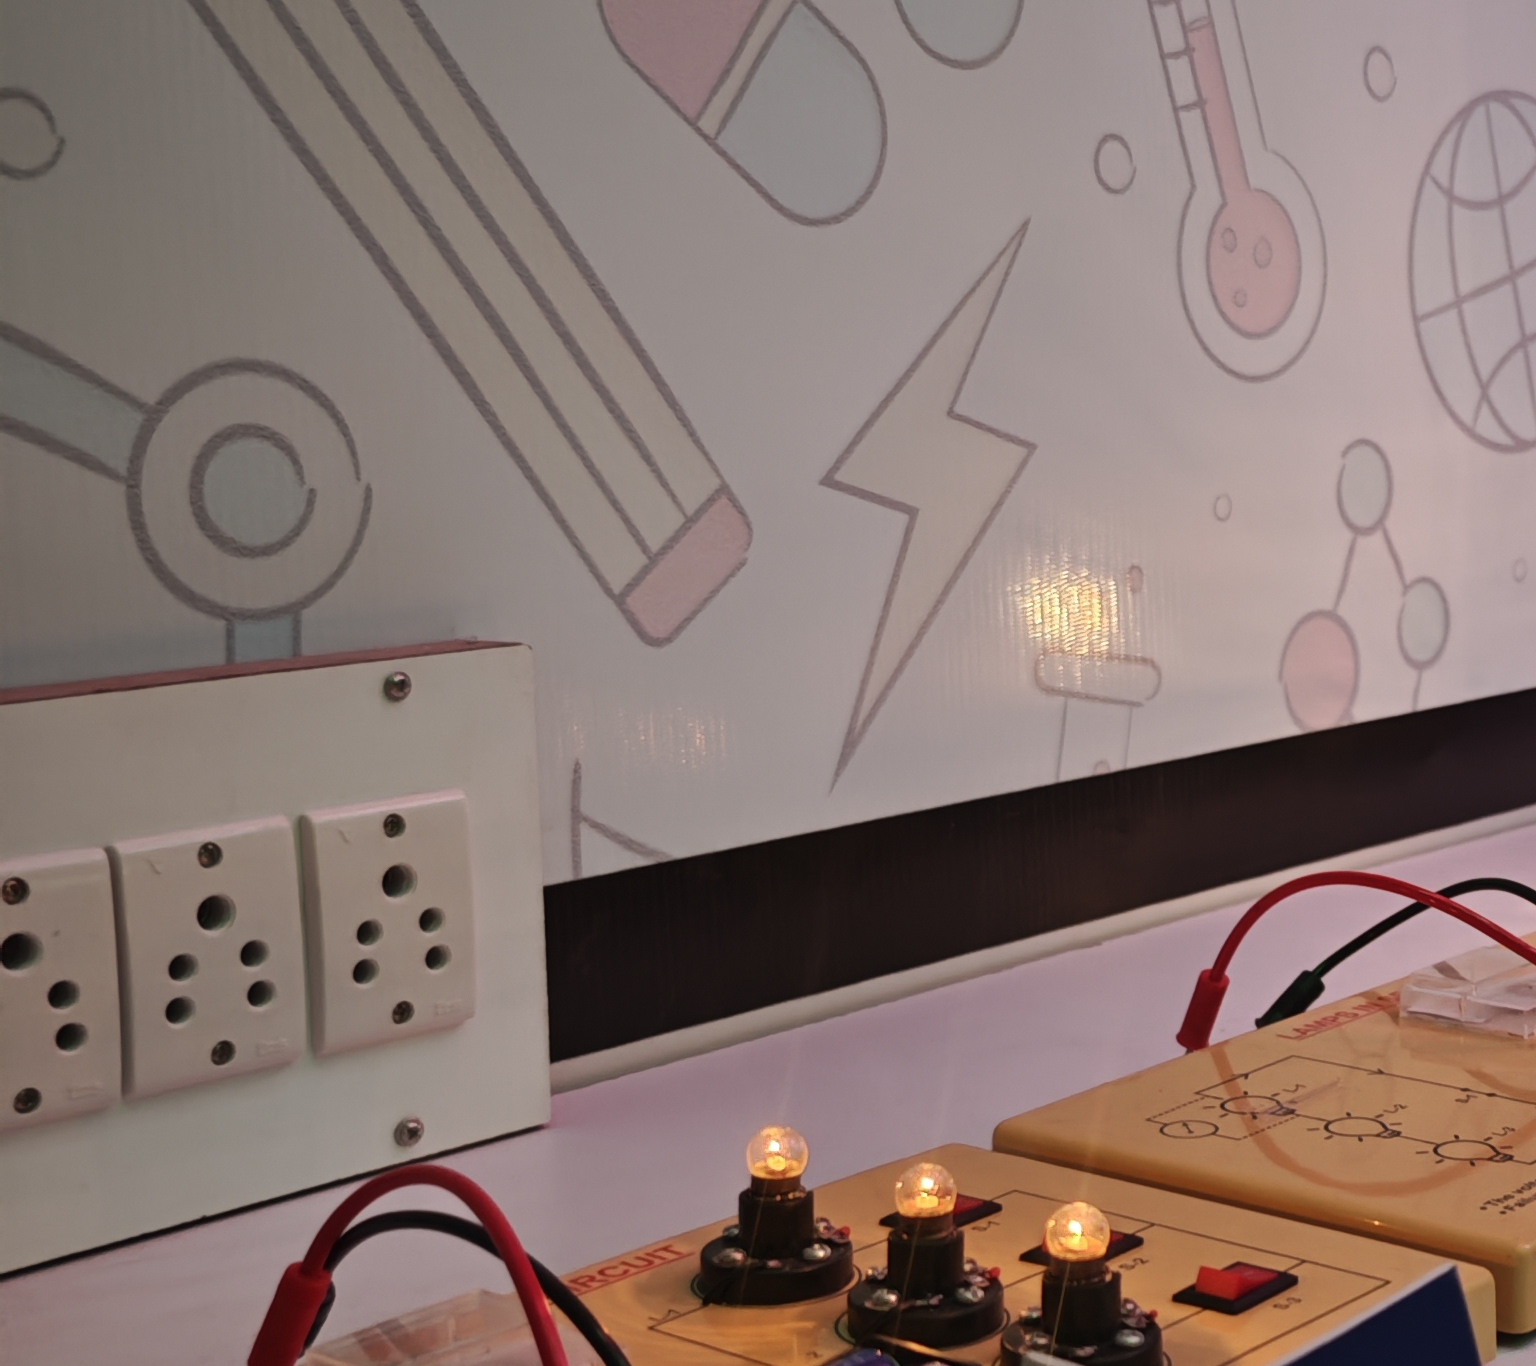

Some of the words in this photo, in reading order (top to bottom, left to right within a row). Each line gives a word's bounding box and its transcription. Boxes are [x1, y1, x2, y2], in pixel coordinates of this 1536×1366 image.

[1483, 1191, 1515, 1208] The
[1118, 1257, 1150, 1271] S-2
[1272, 1296, 1303, 1310] S-3
